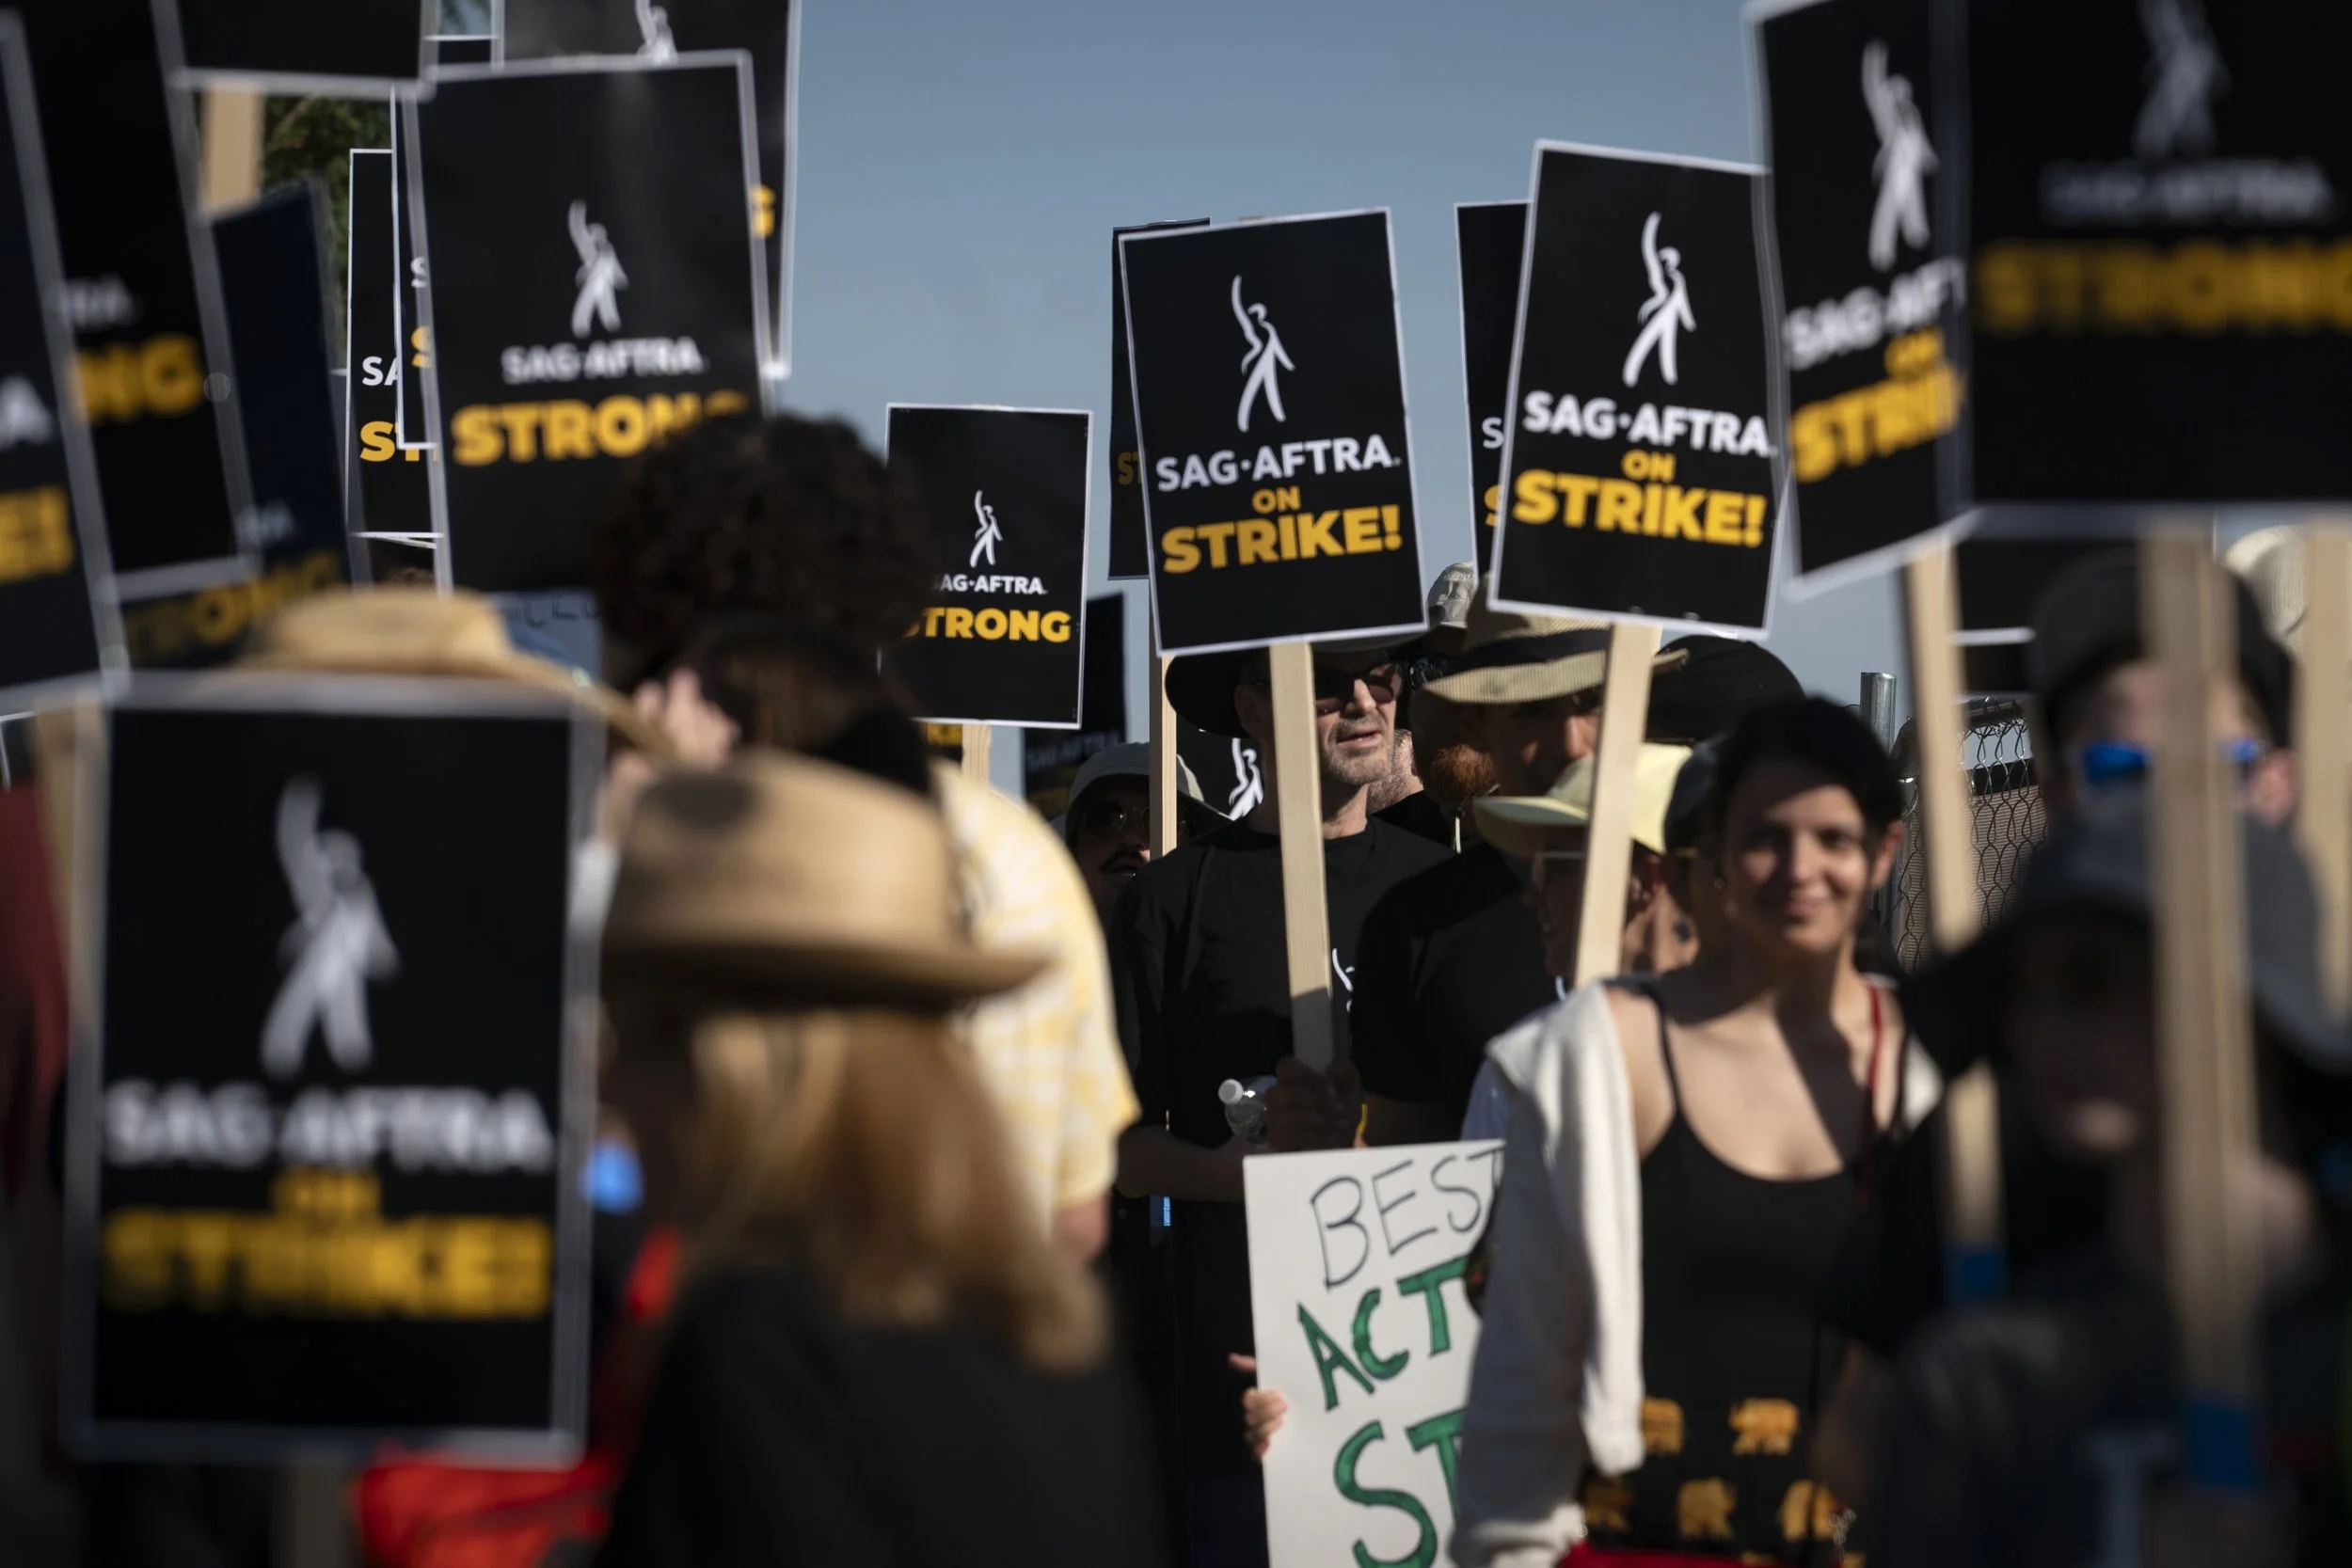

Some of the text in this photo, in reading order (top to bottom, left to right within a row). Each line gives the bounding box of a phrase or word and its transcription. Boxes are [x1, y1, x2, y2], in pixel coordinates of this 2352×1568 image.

[1620, 449, 1677, 482] ON
[1251, 485, 1301, 515] ON
[1512, 467, 1769, 548] STRIKE!
[1161, 504, 1404, 575] STRIKE!
